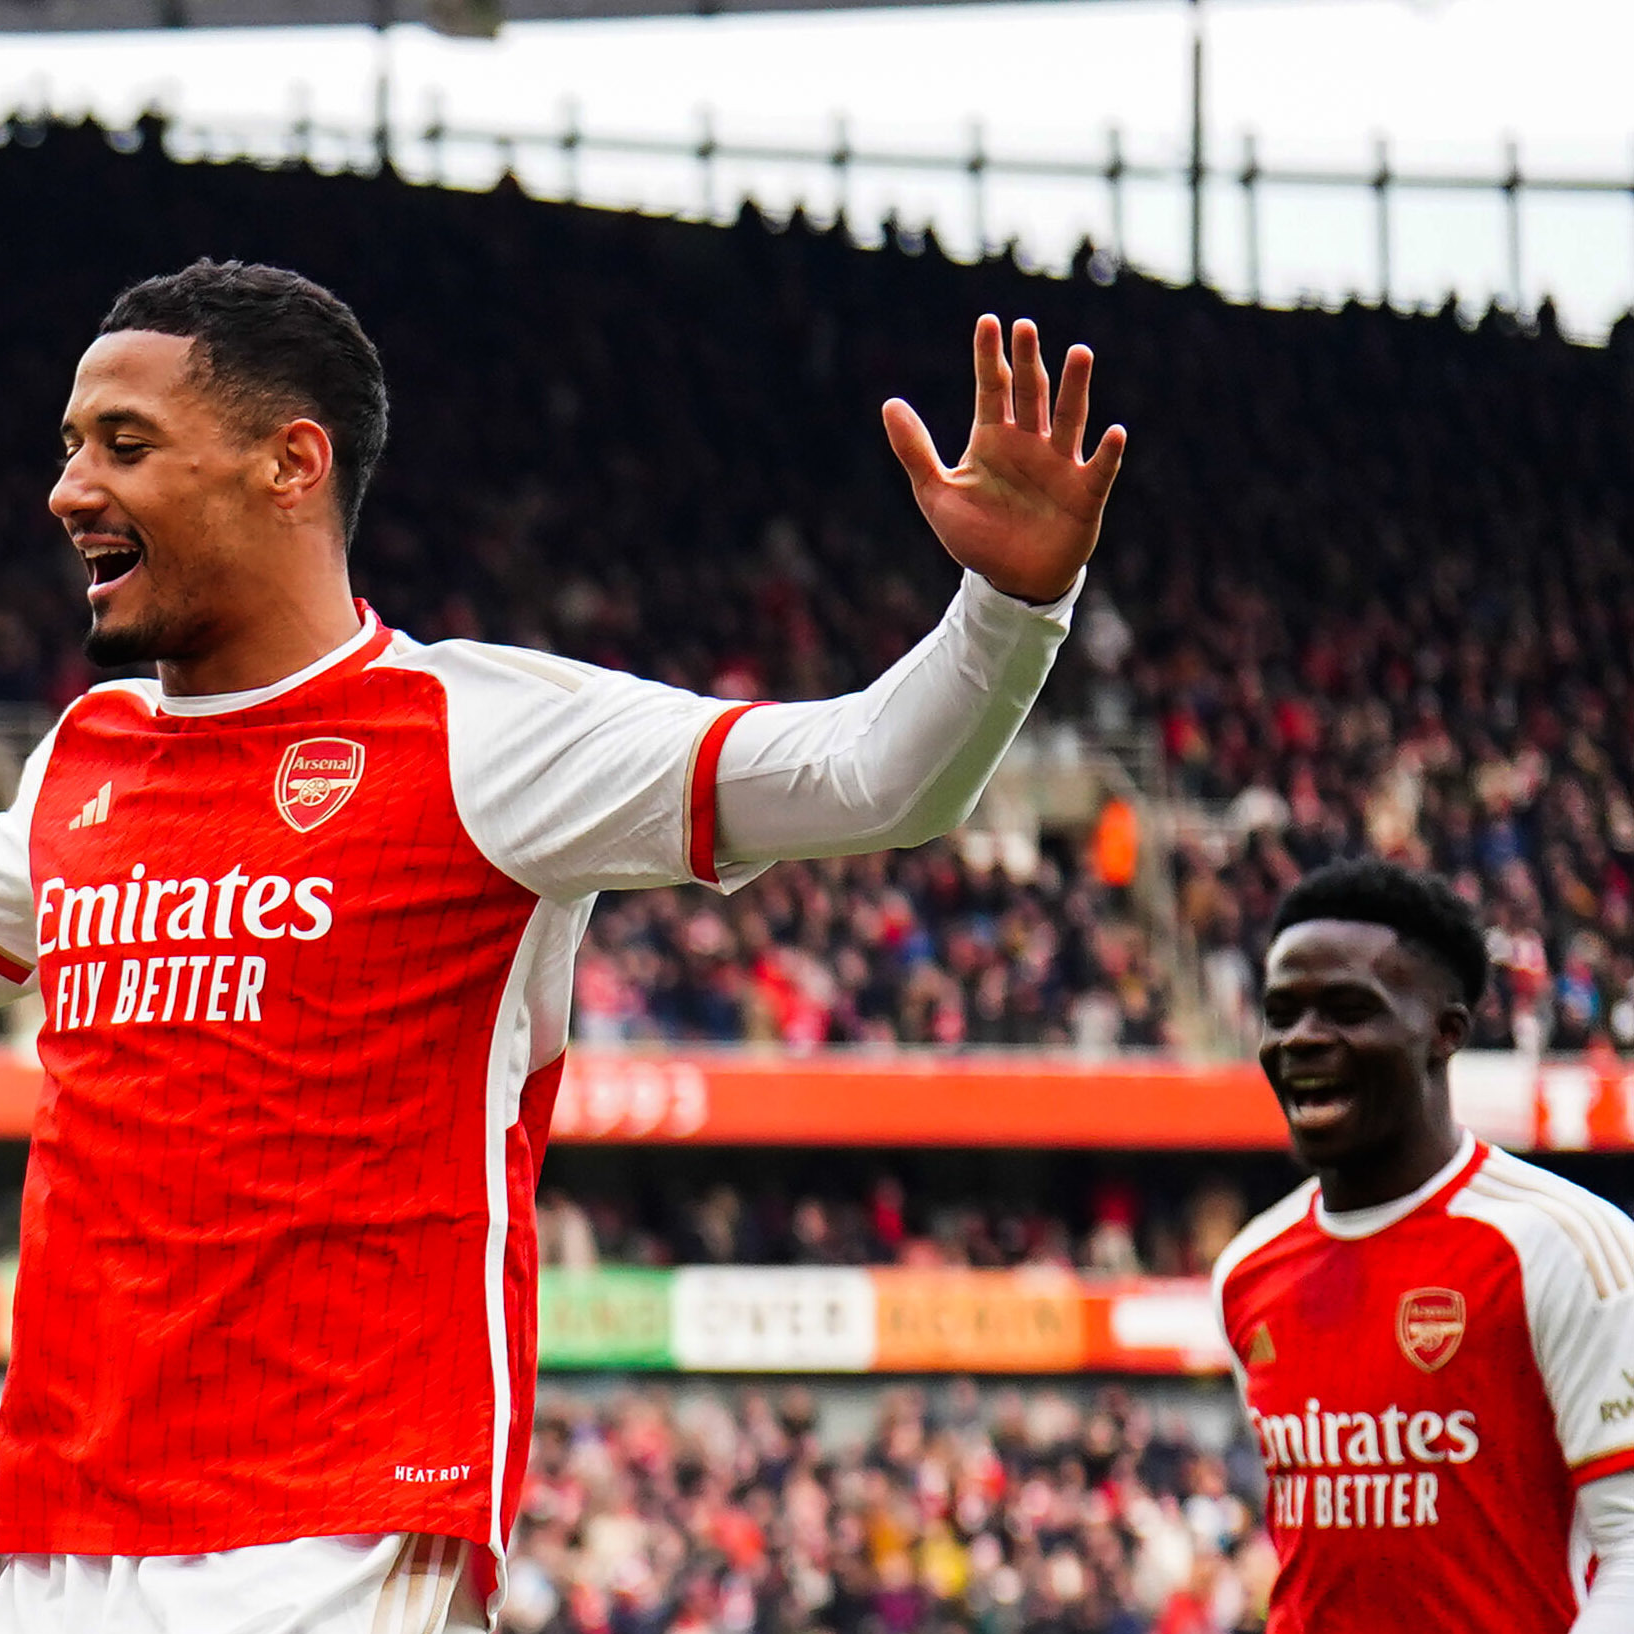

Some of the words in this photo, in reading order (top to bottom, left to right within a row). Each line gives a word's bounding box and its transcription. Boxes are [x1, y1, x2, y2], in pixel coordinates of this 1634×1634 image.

[292, 755, 352, 771] Arsenal
[36, 863, 334, 958] Emirates
[55, 961, 107, 1033] FLY
[110, 955, 267, 1025] BETTER
[394, 1464, 471, 1483] HEAT.RDY
[1313, 1471, 1440, 1530] BETTER
